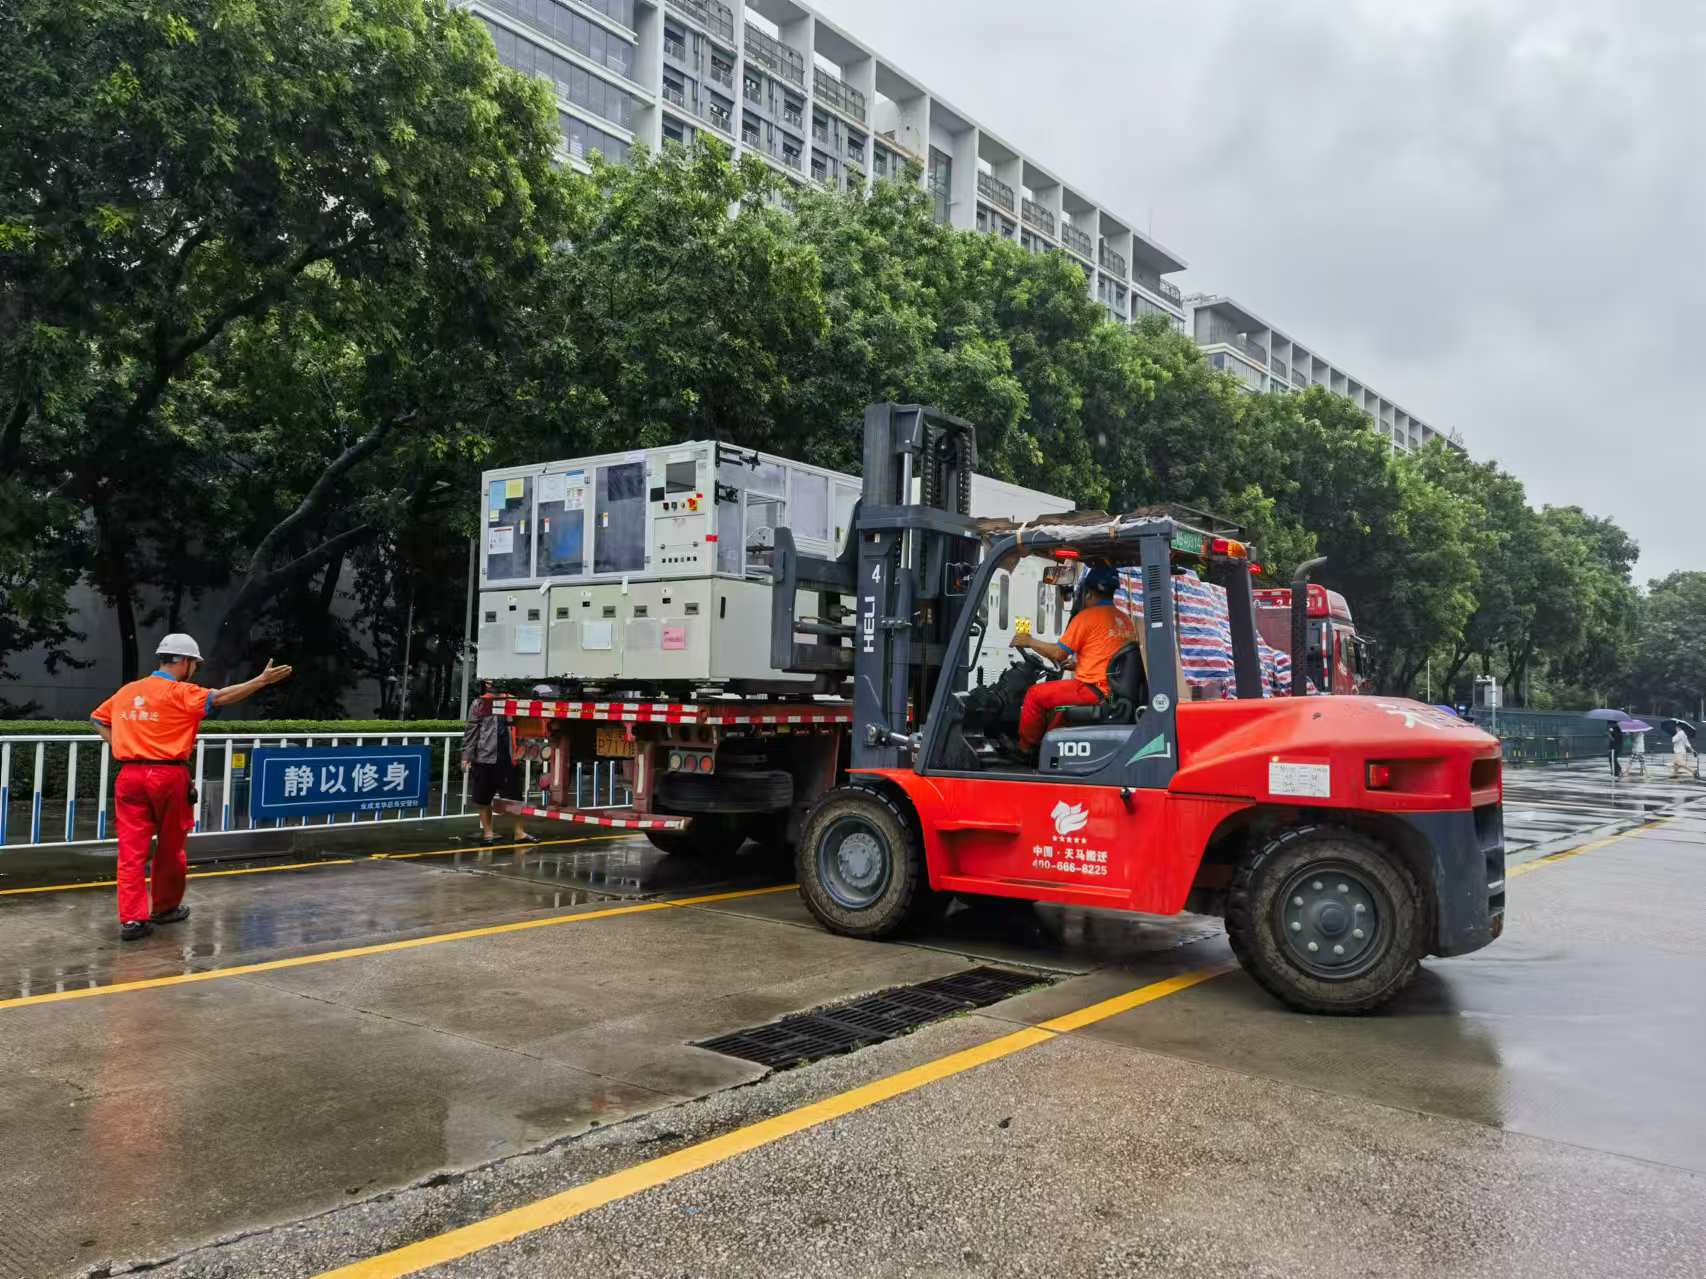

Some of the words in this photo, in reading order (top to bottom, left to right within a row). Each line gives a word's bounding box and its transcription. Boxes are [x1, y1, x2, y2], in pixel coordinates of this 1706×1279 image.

[871, 563, 881, 584] 4
[863, 595, 876, 653] HELI
[1057, 741, 1091, 757] 100
[284, 761, 409, 797] 静以修身
[1032, 859, 1108, 875] 400-666-8225
